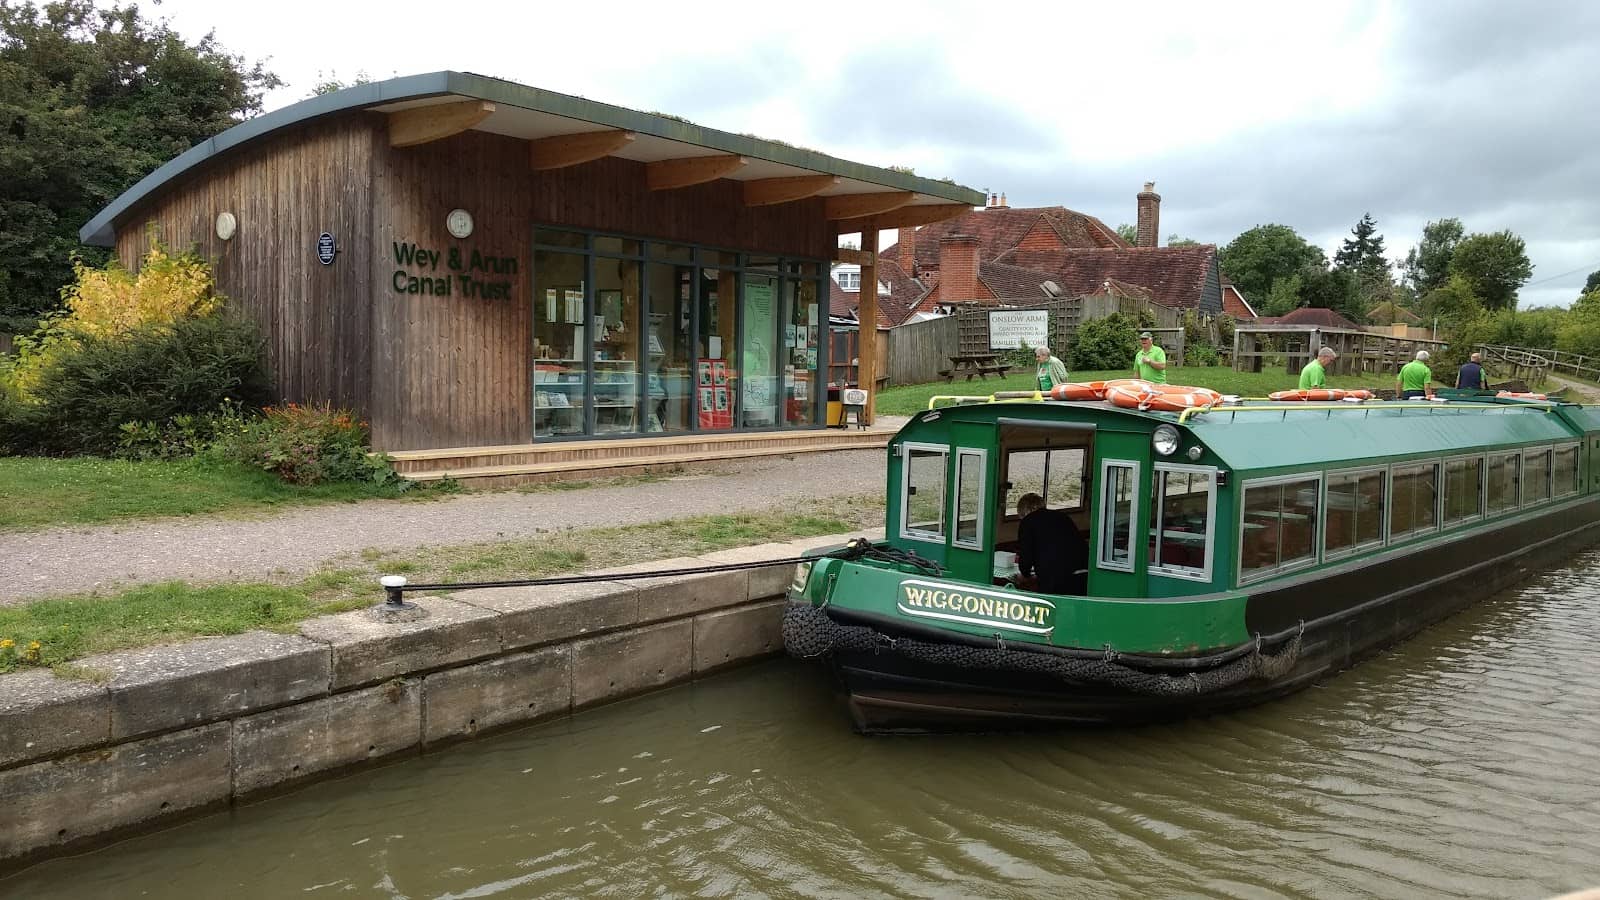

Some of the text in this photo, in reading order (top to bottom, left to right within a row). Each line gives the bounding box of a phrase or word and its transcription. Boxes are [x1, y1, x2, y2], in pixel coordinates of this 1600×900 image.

[393, 241, 518, 275] Wey & Arun
[393, 270, 512, 301] Canal Trust
[904, 586, 1050, 625] WIGGONHOLT
